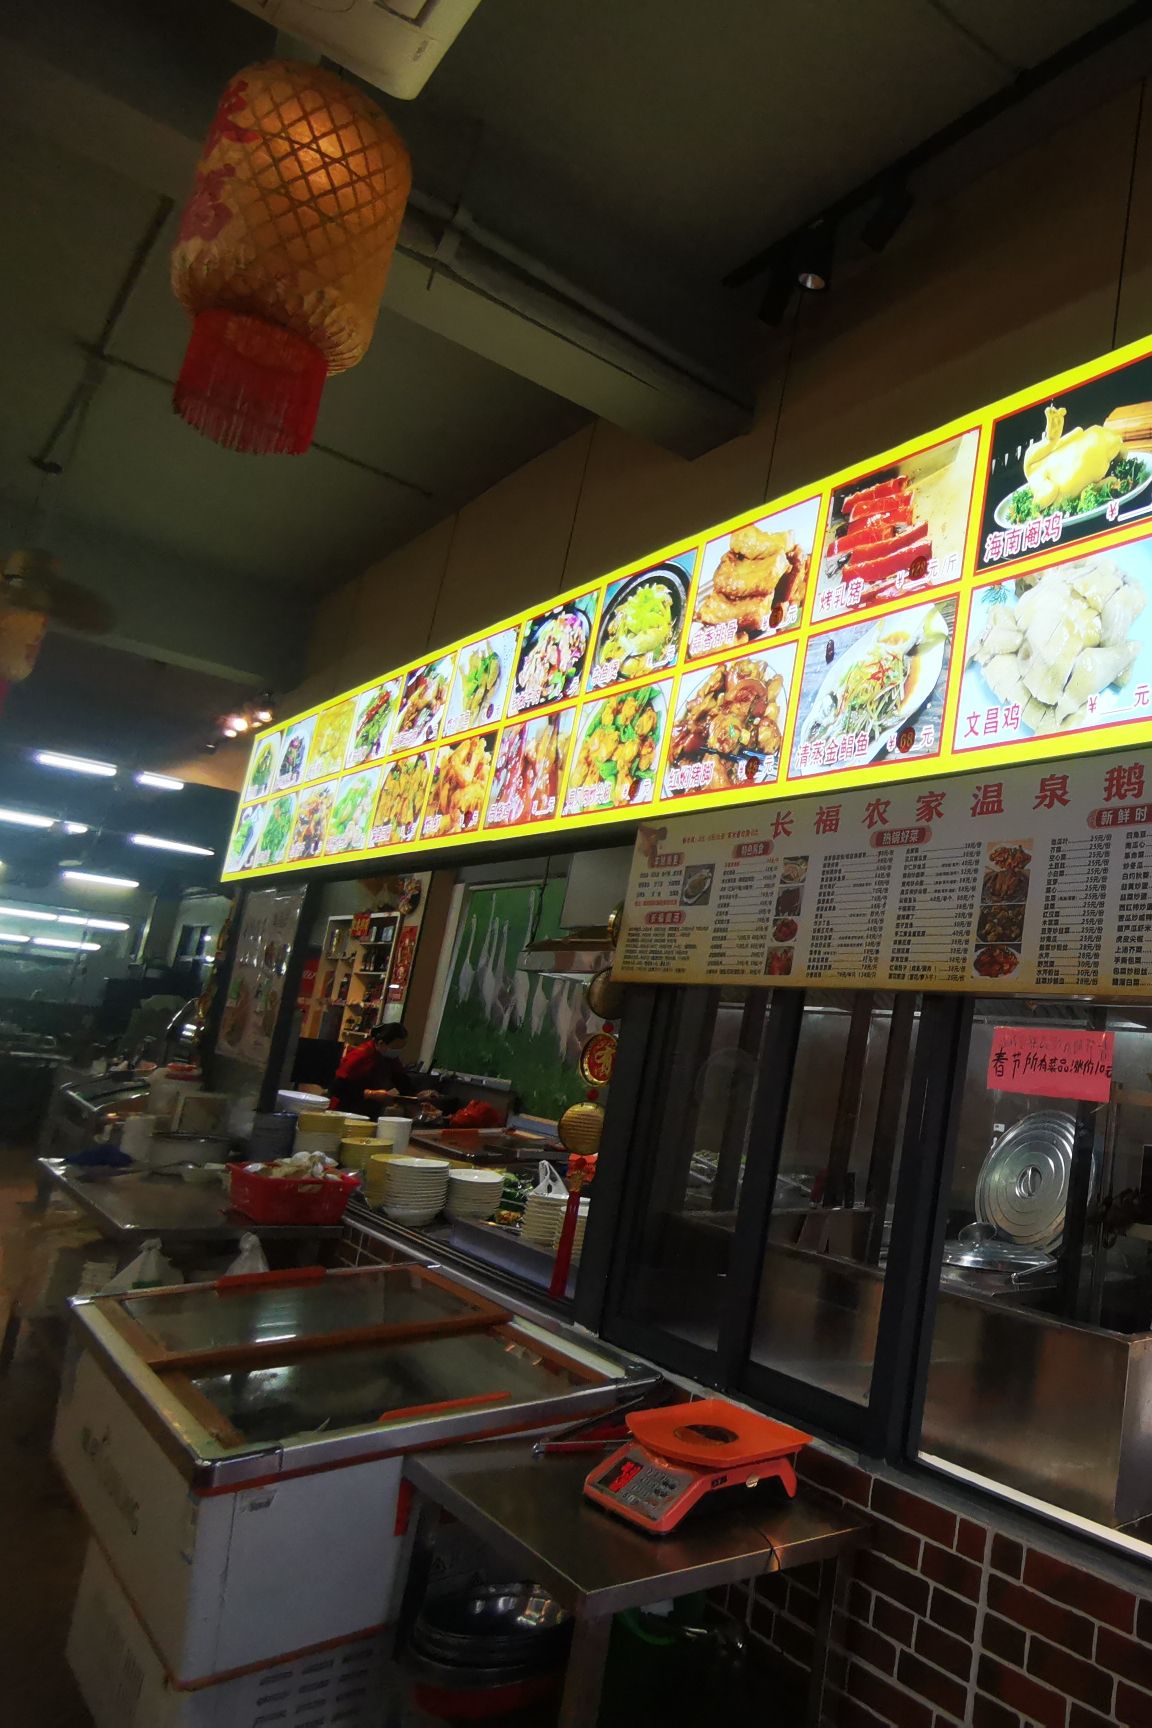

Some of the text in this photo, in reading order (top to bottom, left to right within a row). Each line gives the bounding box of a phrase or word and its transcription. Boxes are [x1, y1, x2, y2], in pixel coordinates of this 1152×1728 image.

[963, 702, 1023, 739] 文昌鸡
[1133, 684, 1150, 708] 元
[795, 730, 870, 770] 清蒸金鲳鱼
[899, 730, 914, 749] 68
[920, 725, 936, 748] 元
[1090, 834, 1113, 842] 25元/份
[1089, 842, 1112, 850] 25元/份
[1086, 875, 1108, 883] 25元/份
[1084, 892, 1107, 900] 25元/份
[1083, 900, 1105, 908] 25元/份
[1082, 909, 1105, 917] 25元/份
[1081, 917, 1104, 925] 25元/份
